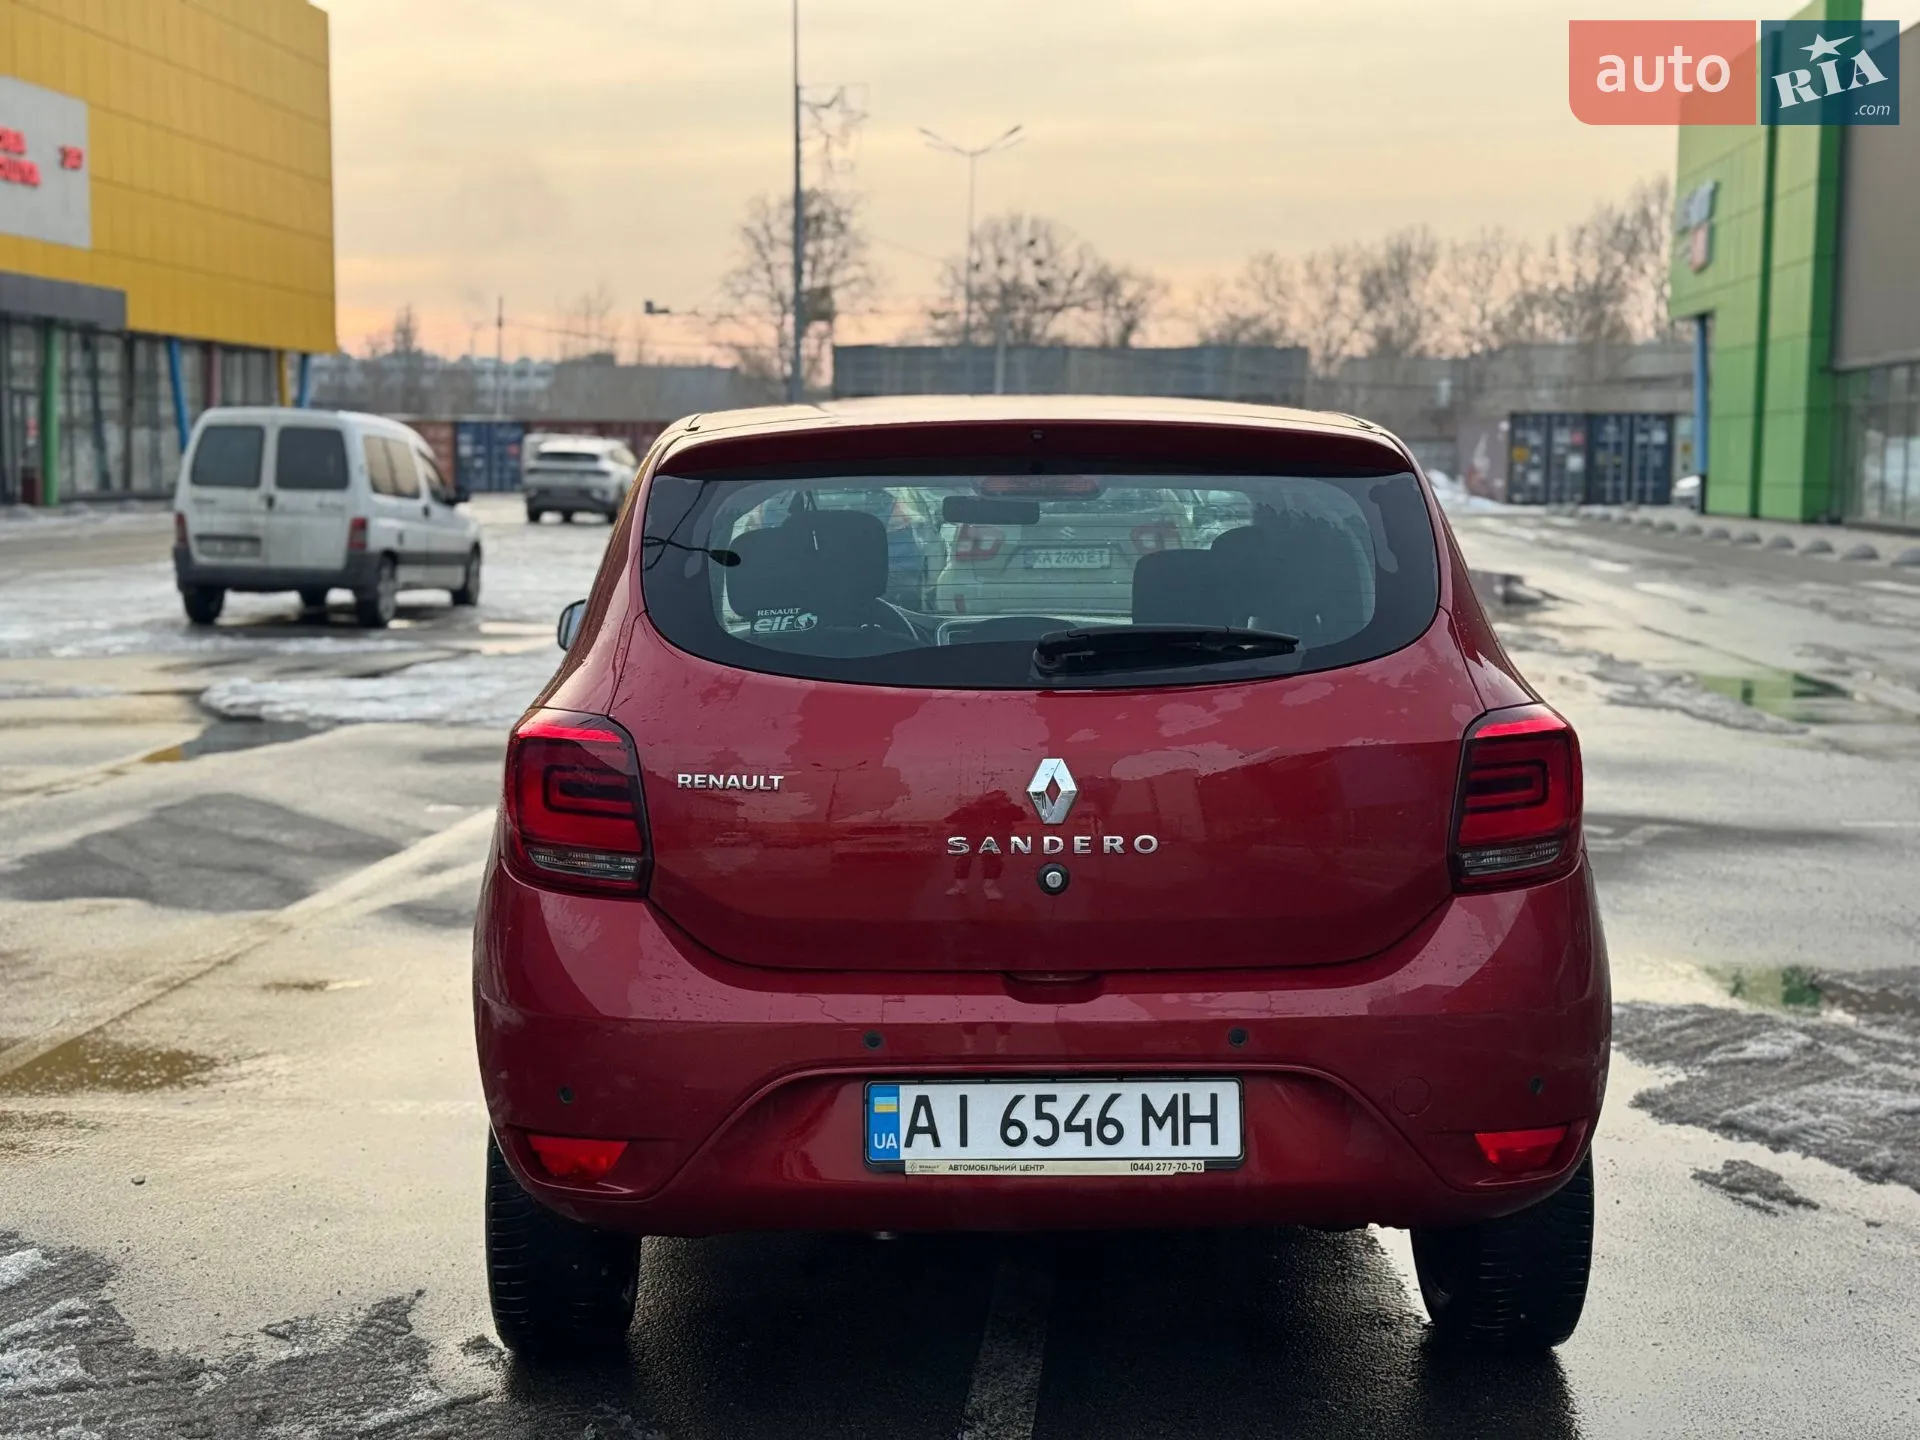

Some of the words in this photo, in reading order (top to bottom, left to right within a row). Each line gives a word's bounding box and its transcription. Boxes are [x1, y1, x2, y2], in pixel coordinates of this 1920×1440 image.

[757, 607, 801, 616] RENAULT
[754, 615, 794, 632] elf
[677, 773, 784, 790] RENAULT
[947, 834, 1159, 854] SANDERO
[1000, 1092, 1124, 1147] 6546
[1141, 1092, 1219, 1146] MH
[874, 1132, 898, 1149] UA
[948, 1163, 1017, 1172] АВТОМОБІЛЬНИЙ
[1019, 1164, 1045, 1172] ЦЕНТР
[1130, 1162, 1154, 1172] (044)
[1156, 1162, 1203, 1171] 277-70-70
